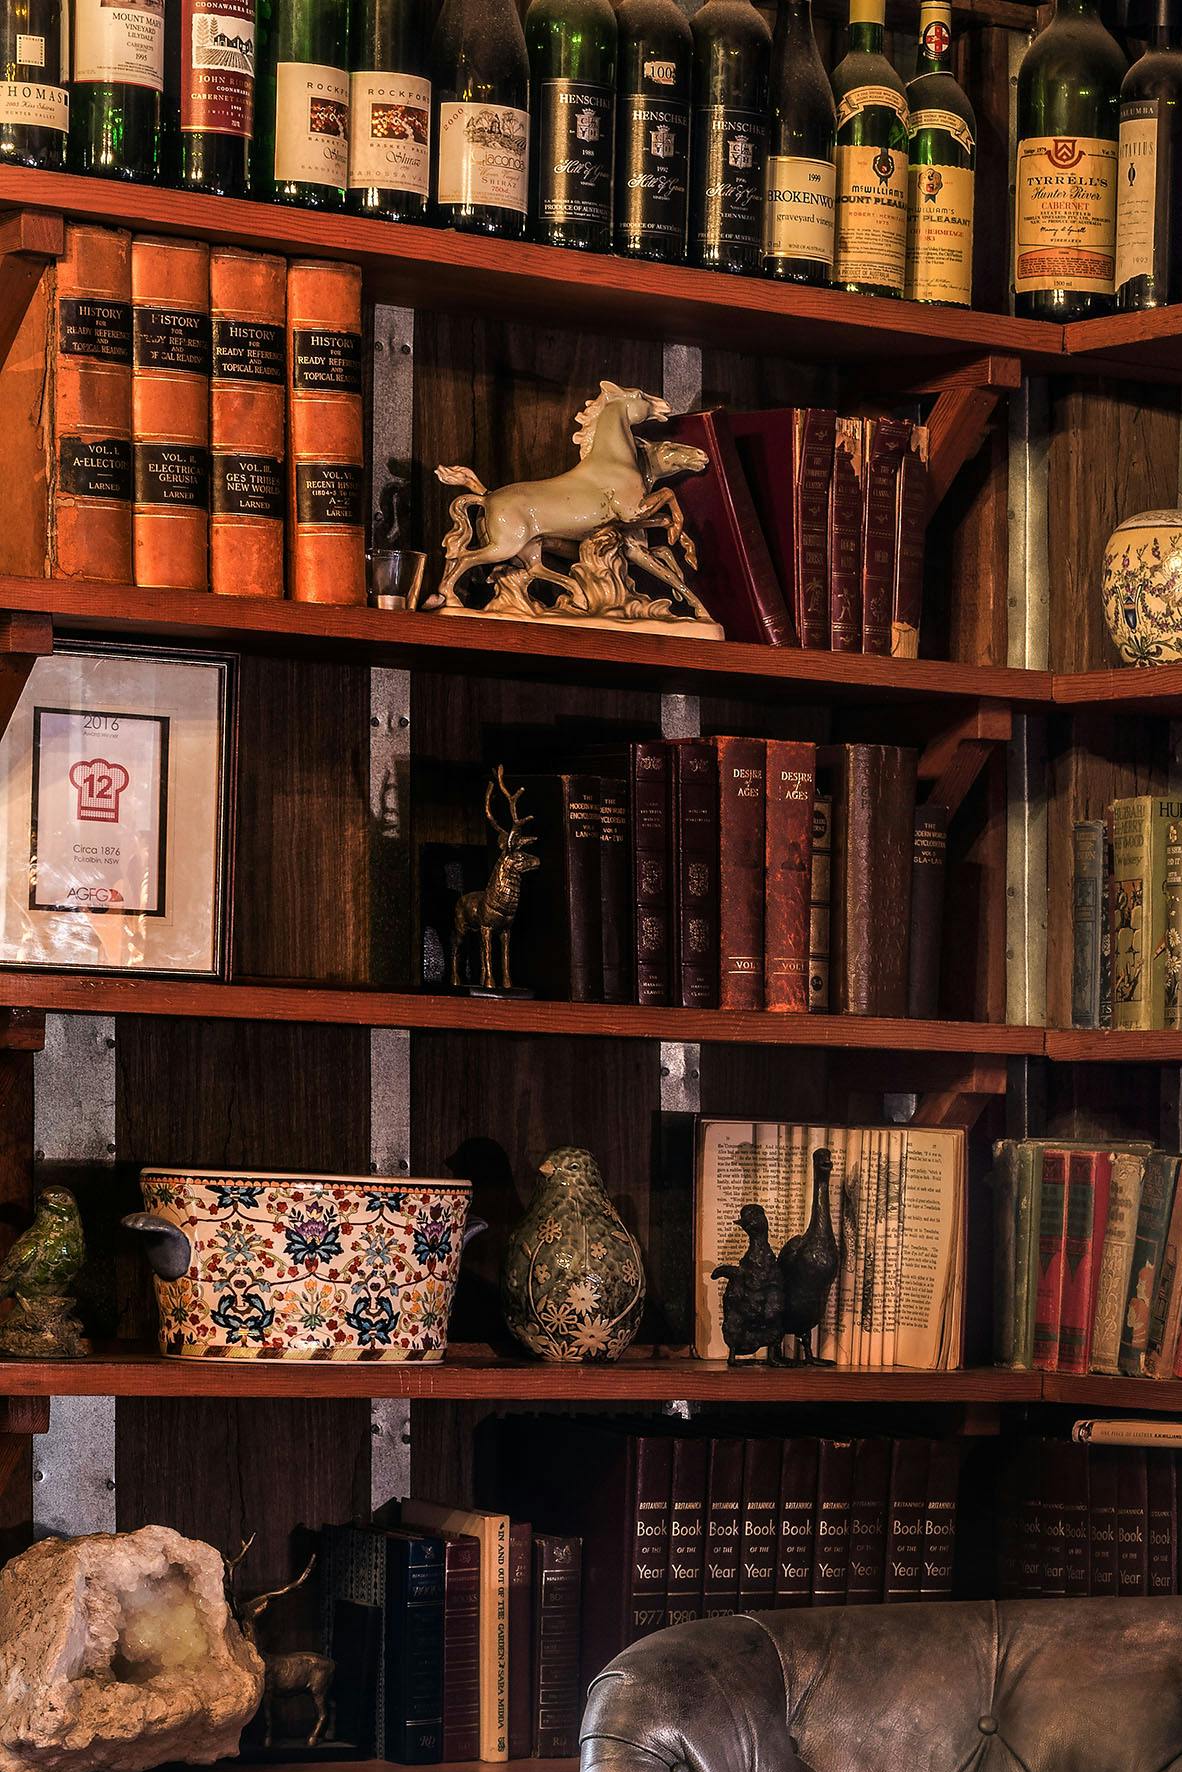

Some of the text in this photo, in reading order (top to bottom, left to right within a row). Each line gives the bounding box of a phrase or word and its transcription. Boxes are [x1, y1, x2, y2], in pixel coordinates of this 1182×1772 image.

[195, 2, 245, 14] COONAWARRA
[113, 12, 162, 29] MOUNT MARY
[125, 23, 156, 35] VINEYARD
[127, 32, 154, 42] LILYDALE
[135, 53, 147, 62] 1995
[198, 75, 226, 83] JOHN
[650, 66, 672, 79] 100
[0, 86, 62, 104] THOMAS
[191, 93, 234, 102] CABERNET
[559, 93, 610, 108] HENSCHKE
[5, 111, 56, 120] HUNTER VALLEY
[443, 107, 465, 132] 2000
[632, 110, 688, 126] HENSCHKE
[712, 120, 766, 136] HENSCHKE
[386, 151, 421, 168] Shiraz
[554, 160, 583, 174] Hill
[350, 170, 407, 179] BAROSSA
[808, 173, 822, 183] 1999
[481, 176, 517, 189] SHIRAZ
[628, 174, 657, 189] Hill
[1027, 176, 1109, 188] TYRRELL'S
[706, 183, 736, 197] Hill
[1031, 186, 1103, 201] Hunter River
[1041, 201, 1090, 211] CABERNET
[776, 213, 815, 226] graveyard
[849, 211, 875, 219] ROBERT
[923, 215, 971, 227] PLEASANT
[806, 244, 826, 253] AUSTRALIA
[869, 270, 890, 278] AUSTRALIA
[79, 305, 122, 320] HISTORY
[152, 313, 200, 329] HISTORY
[66, 326, 93, 336] READY
[229, 326, 276, 341] HISTORY
[311, 336, 354, 349] HISTORY
[216, 346, 245, 357] READY
[298, 355, 326, 365] READY
[222, 362, 253, 374] TOPICAL
[303, 371, 336, 381] TOPICAL
[89, 445, 113, 455] VOL.
[162, 452, 187, 463] VOL.
[239, 462, 263, 473] VOL.
[226, 472, 281, 486] GES TRIBES
[322, 471, 344, 480] VOL.
[88, 482, 121, 492] LARNED
[227, 482, 281, 495] NEW WORLD
[306, 480, 336, 490] RECENT
[163, 490, 195, 500] LARNED
[239, 500, 271, 510] LARNED
[83, 714, 120, 732] 2016
[733, 768, 763, 779] DESIRE
[781, 771, 813, 783] DESIRE
[83, 773, 113, 800] 12
[737, 787, 759, 797] AGES
[785, 790, 808, 801] AGES
[73, 843, 121, 857] Circa 1876
[103, 857, 120, 865] NSW
[66, 887, 109, 902] AGFG
[640, 1502, 667, 1510] BRITANNICA
[674, 1502, 702, 1510] BRITANNICA
[747, 1502, 776, 1510] BRITANNICA
[785, 1502, 813, 1510] BRITANNICA
[637, 1519, 667, 1537] Book
[672, 1519, 703, 1537] Book
[709, 1519, 740, 1537] Book
[745, 1519, 776, 1536] Book
[782, 1519, 813, 1536] Book
[820, 1519, 850, 1536] Book
[893, 1519, 923, 1535] Book
[925, 1519, 956, 1535] Book
[636, 1564, 665, 1579] Year
[671, 1564, 700, 1579] Year
[708, 1564, 737, 1579] Year
[744, 1563, 773, 1578] Year
[781, 1563, 810, 1578] Year
[819, 1563, 846, 1578] Year
[892, 1561, 920, 1577] Year
[924, 1561, 952, 1577] Year
[633, 1610, 665, 1626] 1977
[668, 1610, 697, 1626] 1980
[497, 1530, 505, 1730] IN AND OUT OF THE GARDEN SARA MIDDA
